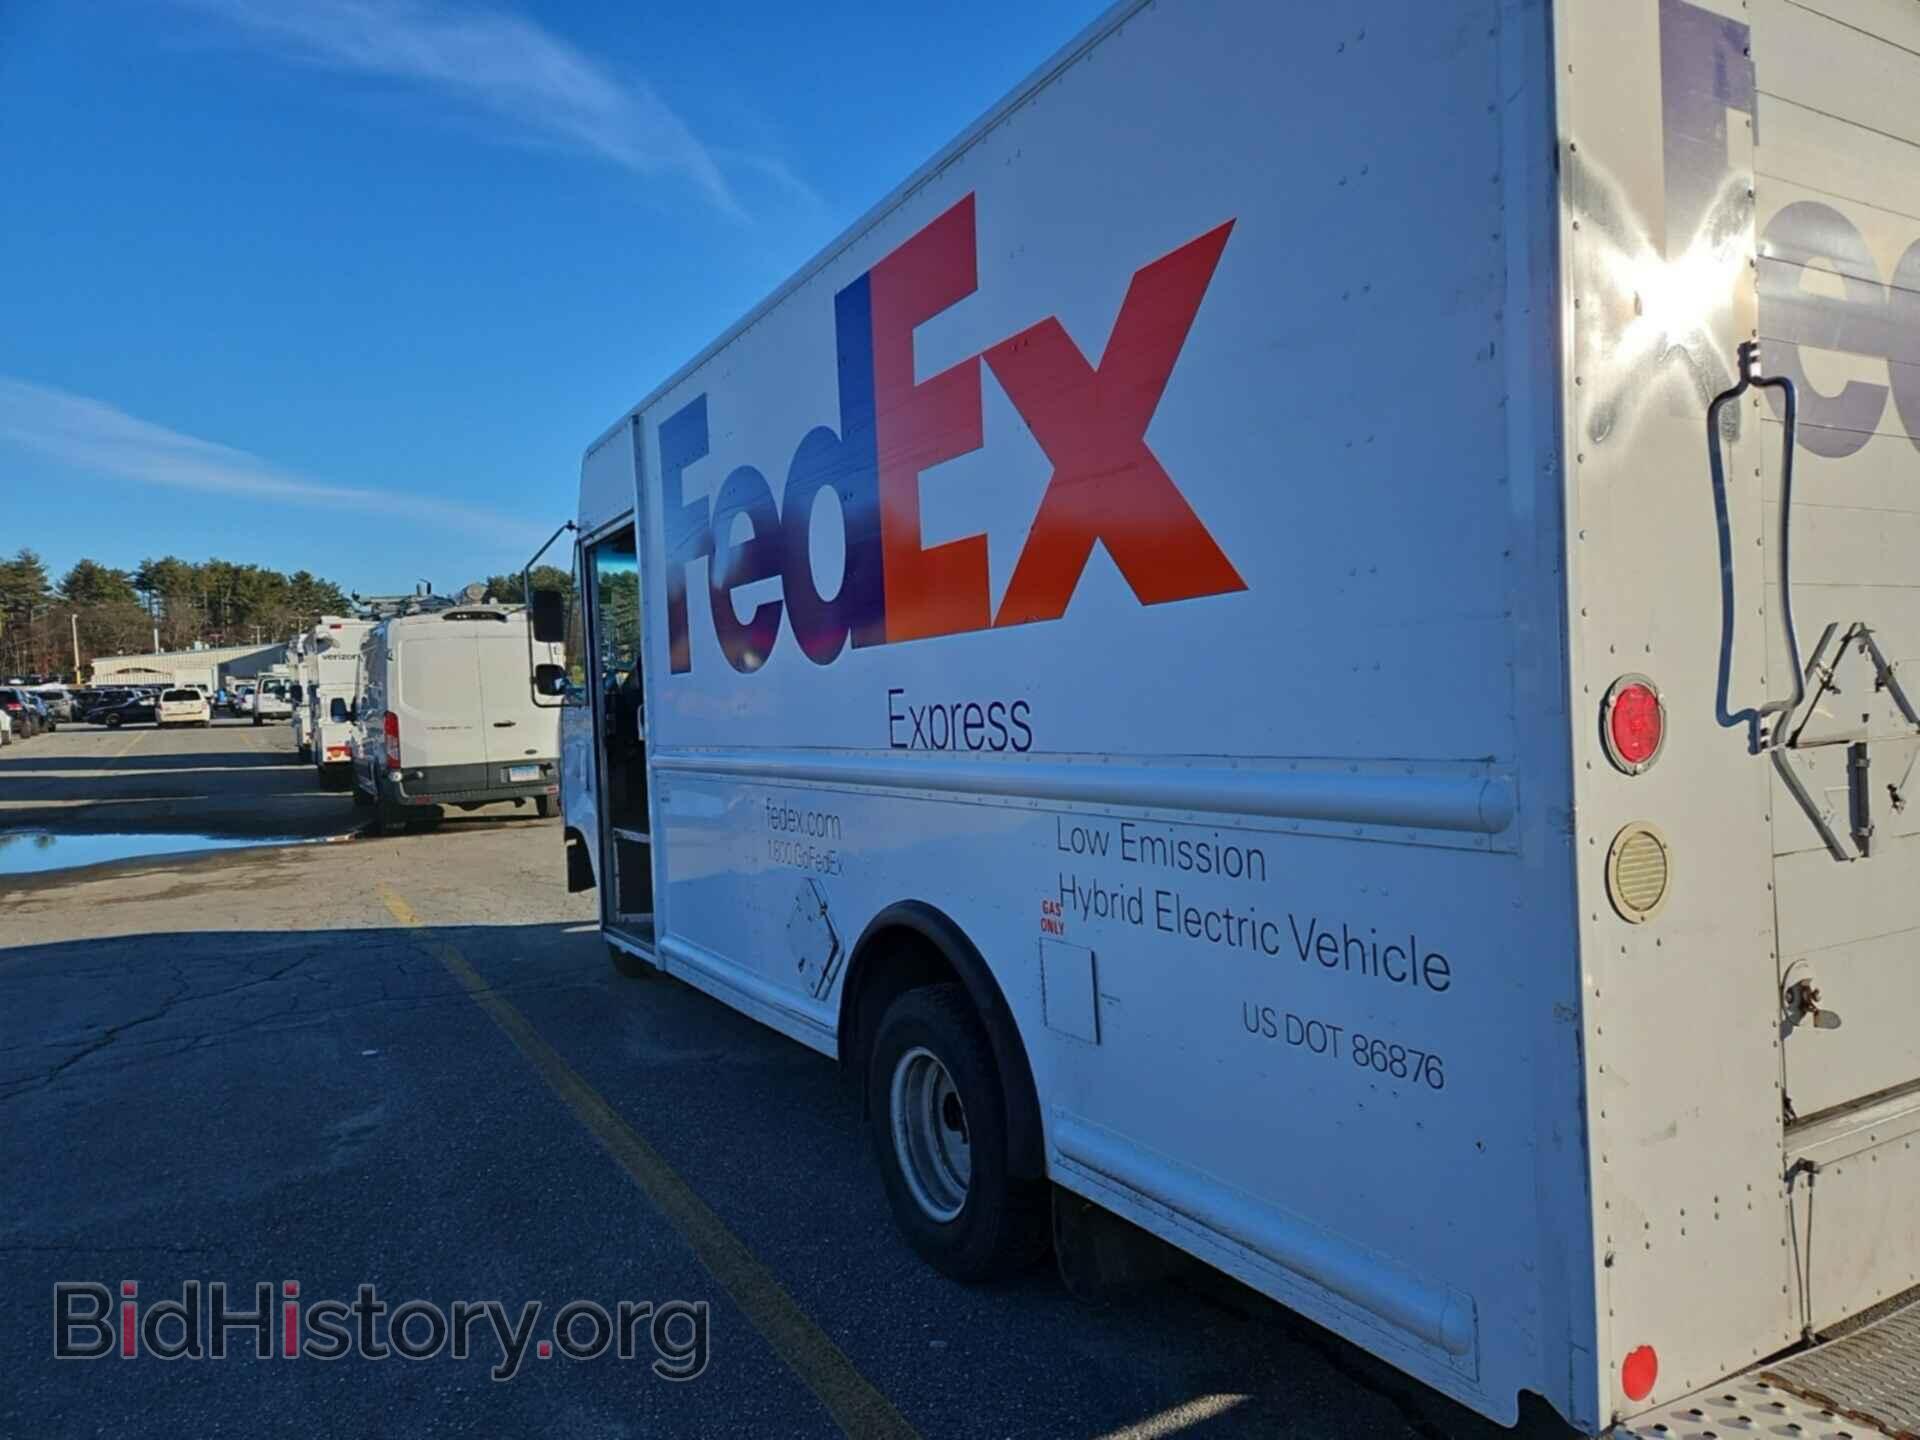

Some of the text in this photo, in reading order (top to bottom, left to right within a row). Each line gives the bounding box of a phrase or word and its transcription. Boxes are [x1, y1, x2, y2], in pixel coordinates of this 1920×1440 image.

[658, 191, 1249, 675] FedEx
[888, 688, 1033, 753] Express
[765, 797, 842, 841] fedex.com
[1056, 815, 1267, 882] Low Emission
[1040, 917, 1065, 937] ONLY
[1042, 899, 1062, 917] GAS
[1059, 872, 1452, 993] Hybrid Electric Vehicle
[1242, 1001, 1445, 1090] US DOT 86876
